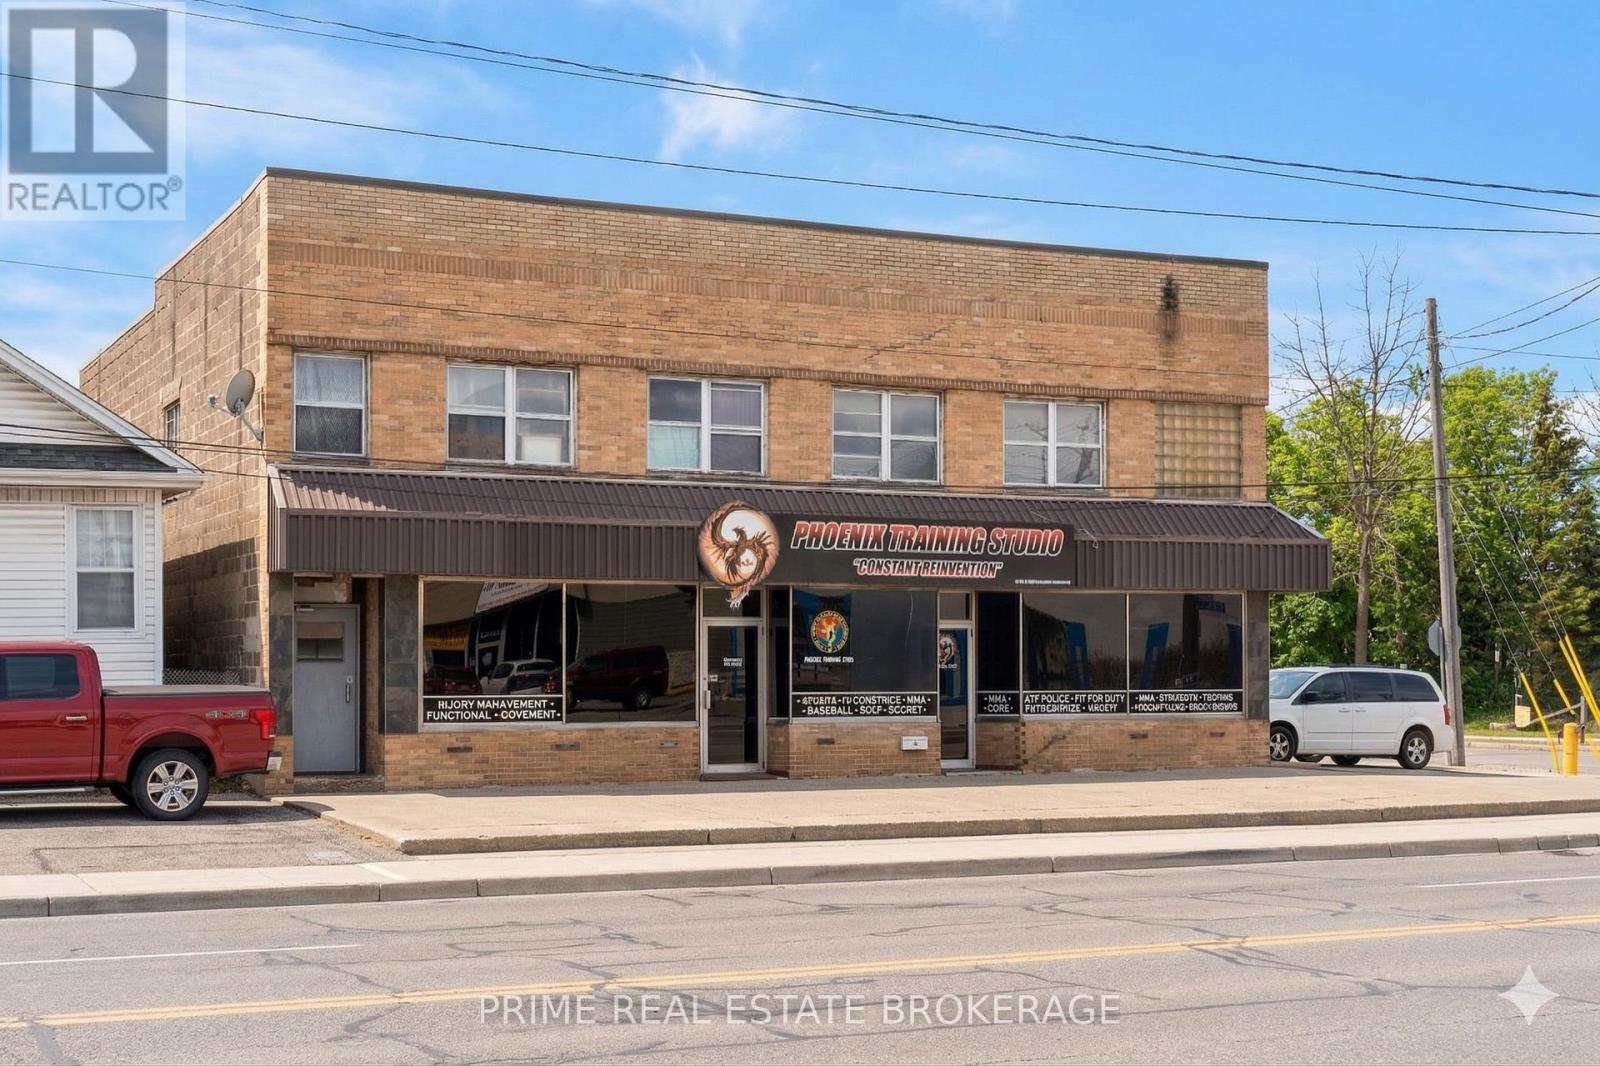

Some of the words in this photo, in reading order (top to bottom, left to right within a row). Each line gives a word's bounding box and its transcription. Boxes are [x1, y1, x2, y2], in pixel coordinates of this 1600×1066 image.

[791, 521, 887, 552] PHOENIX
[889, 523, 987, 555] TRAINING
[988, 528, 1064, 557] STUDIO
[907, 695, 926, 704] MMA
[1041, 694, 1070, 703] POLICE
[1075, 694, 1087, 703] FIT
[1087, 694, 1104, 703] FOR
[1105, 694, 1125, 703] DUTY
[807, 706, 853, 715] BASEBALL
[987, 704, 1010, 713] CORE
[427, 711, 491, 720] FUNCTIONAL
